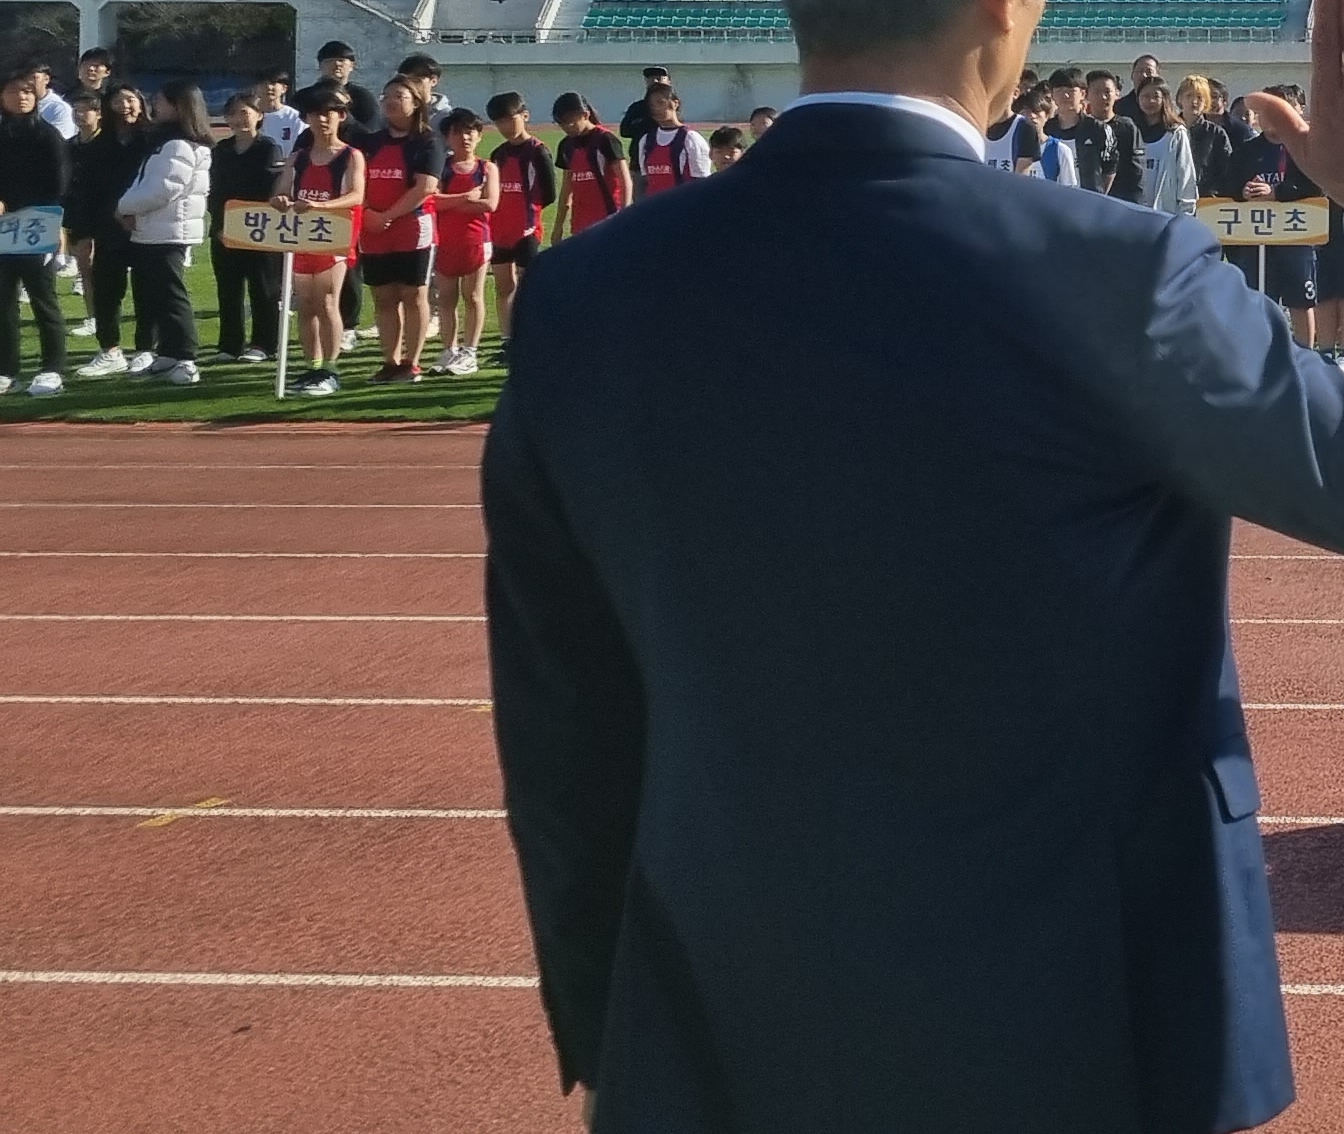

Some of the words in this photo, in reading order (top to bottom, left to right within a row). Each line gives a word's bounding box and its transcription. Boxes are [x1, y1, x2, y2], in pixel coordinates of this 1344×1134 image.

[244, 211, 333, 244] 방산초
[1217, 208, 1308, 236] 구만초
[1304, 280, 1316, 300] 3
